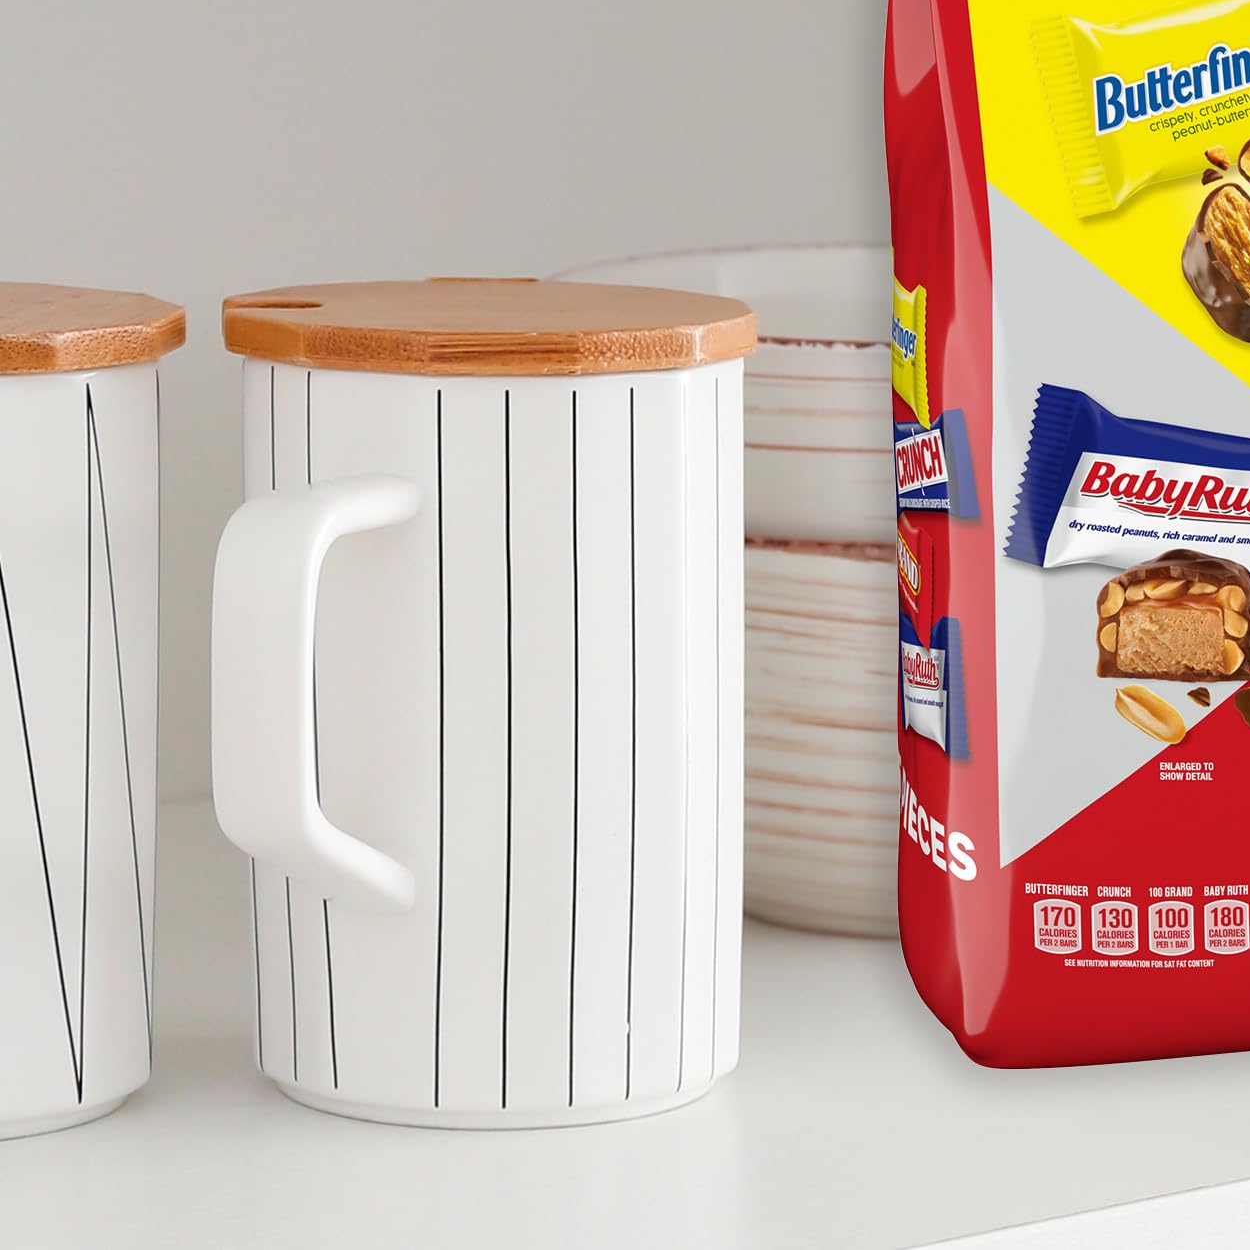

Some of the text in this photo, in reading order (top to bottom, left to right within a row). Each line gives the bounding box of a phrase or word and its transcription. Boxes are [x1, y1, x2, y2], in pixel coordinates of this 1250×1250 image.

[1150, 111, 1197, 132] crispety,
[897, 435, 942, 488] CRUNCH
[1068, 519, 1085, 531] dry
[1087, 522, 1121, 534] roasted
[1122, 526, 1160, 539] peanuts,
[1162, 530, 1180, 540] rich
[1181, 532, 1216, 543] caramel
[1218, 535, 1235, 544] and
[1160, 762, 1214, 771] ENLARGED TO
[1160, 772, 1213, 781] SHOW DETAIL
[1025, 883, 1088, 897] BUTTERFINGER
[1097, 886, 1132, 897] CRUNCH
[1149, 886, 1193, 897] 100 GRAND
[1203, 884, 1249, 897] BABY RUTH
[1040, 906, 1076, 927] 170
[1098, 908, 1133, 929] 130
[1155, 908, 1189, 928] 100
[1210, 906, 1244, 927] 180
[1039, 928, 1077, 938] CALORIES
[1096, 930, 1135, 939] CALORIES
[1153, 930, 1191, 939] CALORIES
[1208, 929, 1246, 938] CALORIES
[1228, 939, 1246, 947] BARS
[1077, 959, 1109, 967] NUTRITION
[1109, 960, 1150, 968] INFORMATION
[1151, 960, 1163, 968] FOR
[1163, 960, 1175, 968] SAT
[1176, 960, 1187, 968] FAT
[1187, 959, 1215, 967] CONTENT
